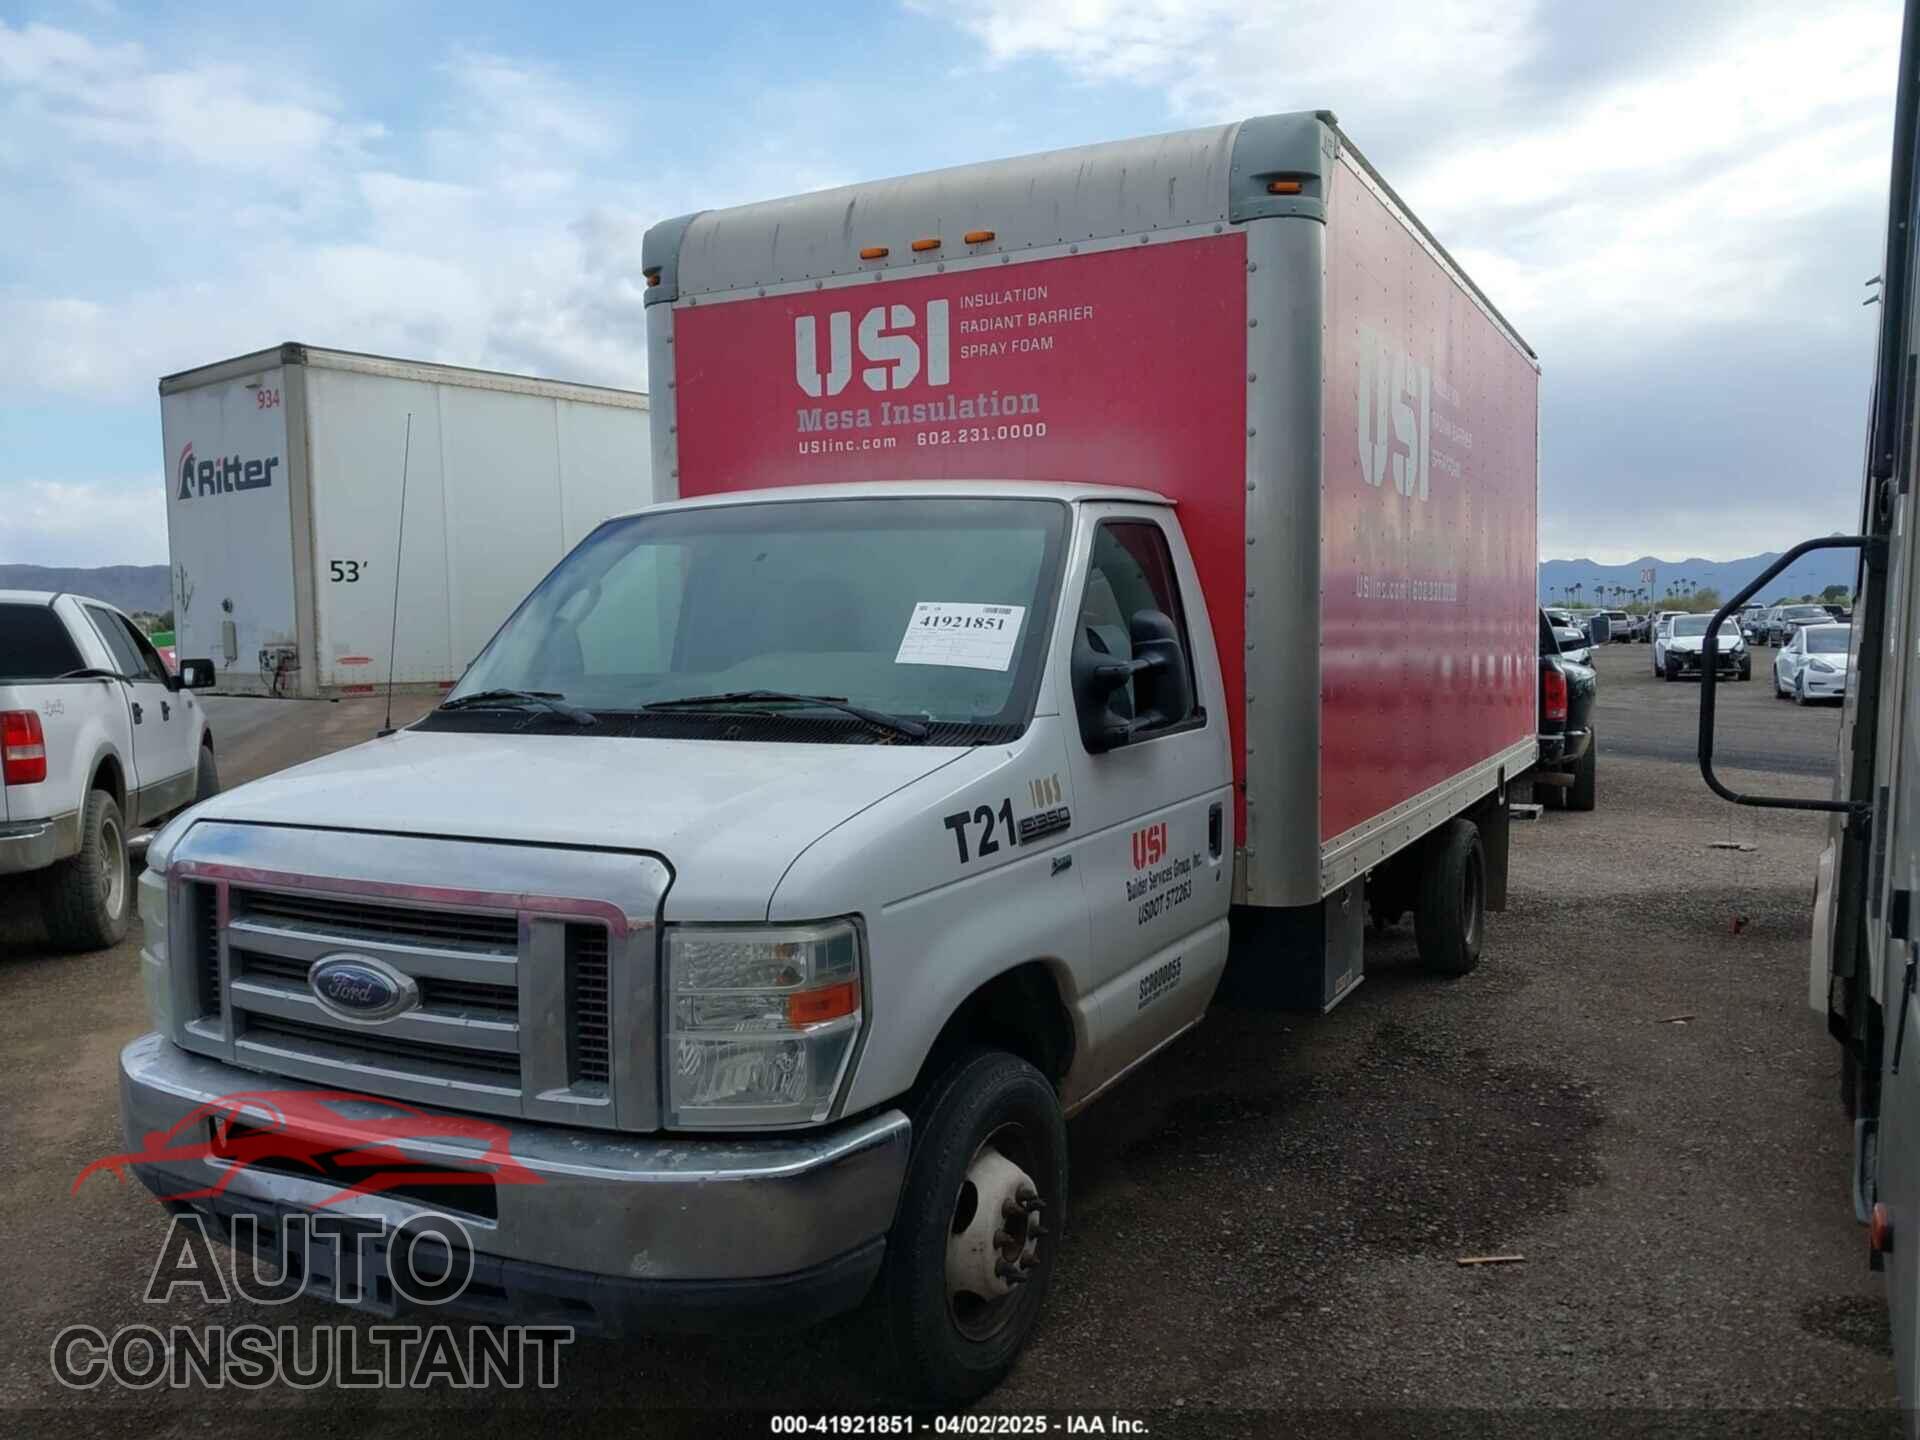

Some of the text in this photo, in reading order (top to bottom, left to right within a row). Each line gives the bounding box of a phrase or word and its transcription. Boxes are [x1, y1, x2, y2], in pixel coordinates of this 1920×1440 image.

[960, 286, 1048, 309] INSULATION
[960, 306, 1093, 334] RADIANT BARRIER
[795, 299, 950, 397] USI
[960, 336, 1054, 359] SPRAY FOAM
[256, 389, 280, 409] 934
[797, 390, 1041, 433] Mesa Insulation
[1358, 328, 1431, 502] USI
[799, 422, 1047, 454] USIinc.com 602.231.0000
[197, 455, 279, 497] Ritter
[920, 615, 1006, 631] 41921851
[944, 798, 1017, 865] T21
[1132, 822, 1167, 871] USI
[1139, 894, 1165, 925] USDOT
[327, 971, 373, 1002] Ford
